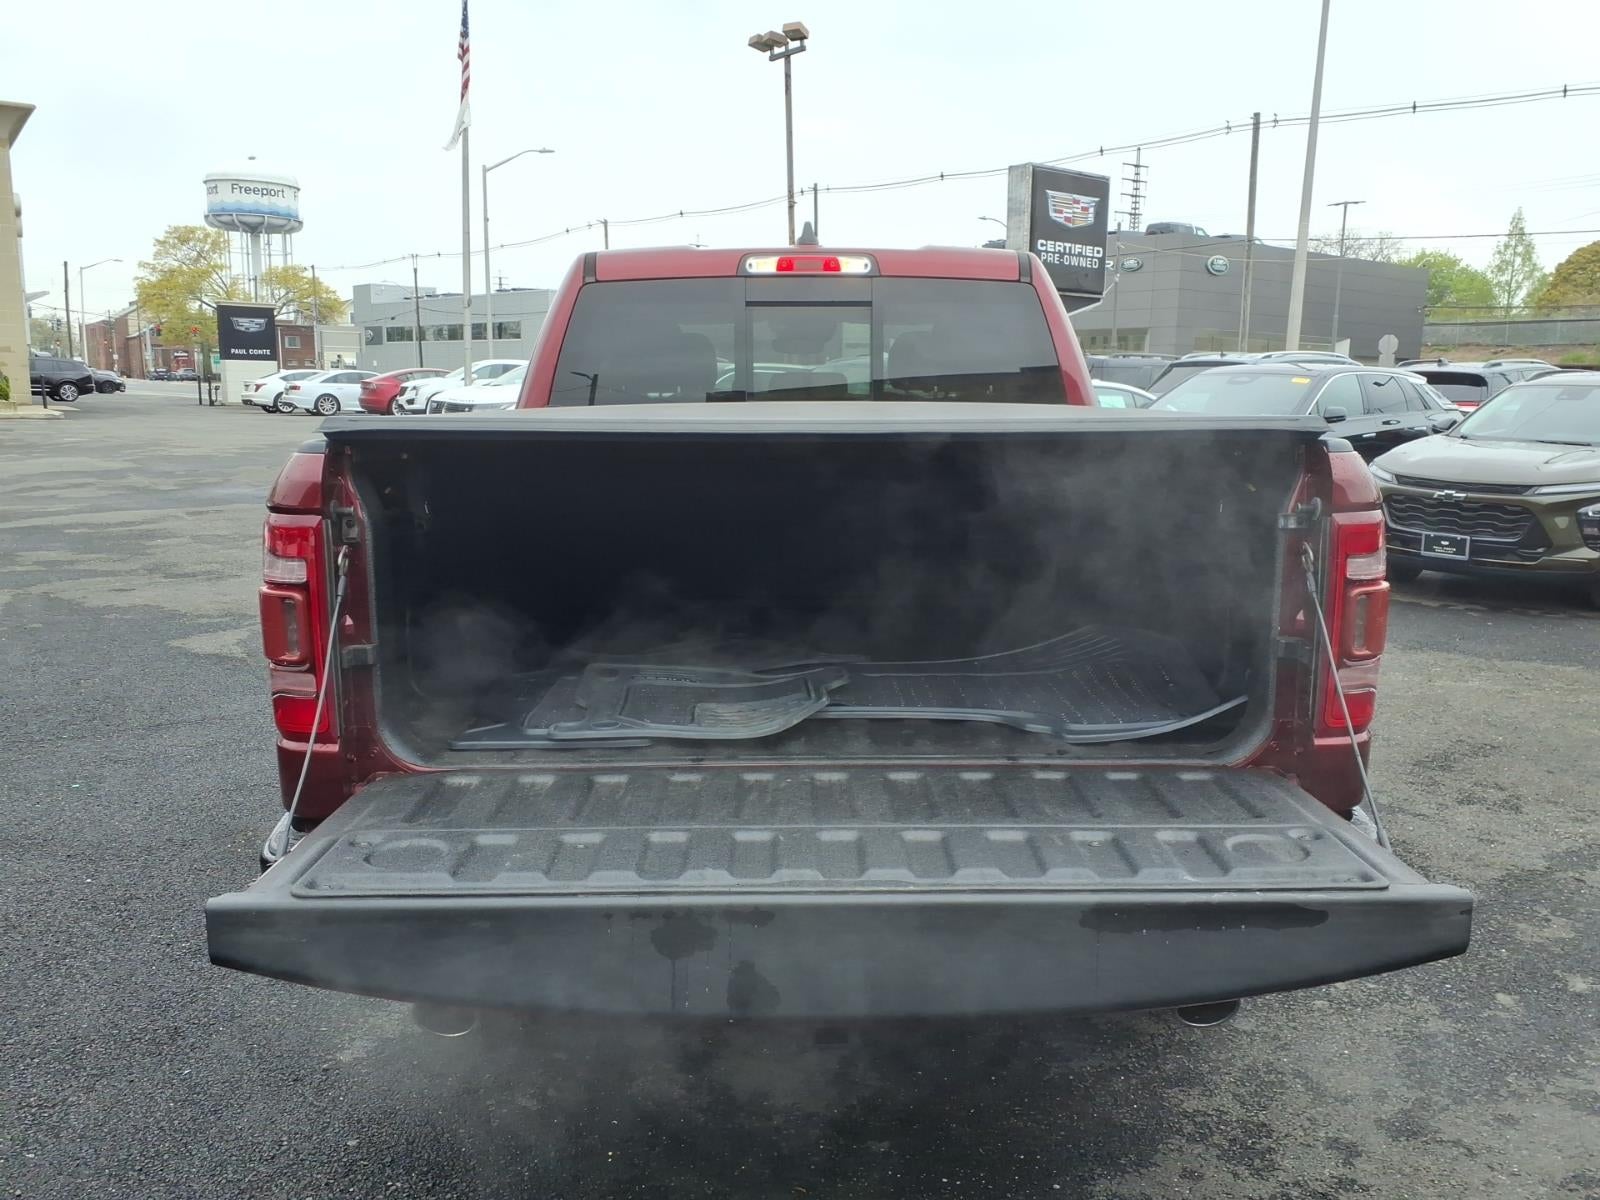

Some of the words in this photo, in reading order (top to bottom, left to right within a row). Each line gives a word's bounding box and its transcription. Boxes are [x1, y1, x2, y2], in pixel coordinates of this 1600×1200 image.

[231, 183, 286, 198] Freeport
[1037, 239, 1103, 258] CERTIFIED
[1040, 252, 1099, 269] PRE-OWNED
